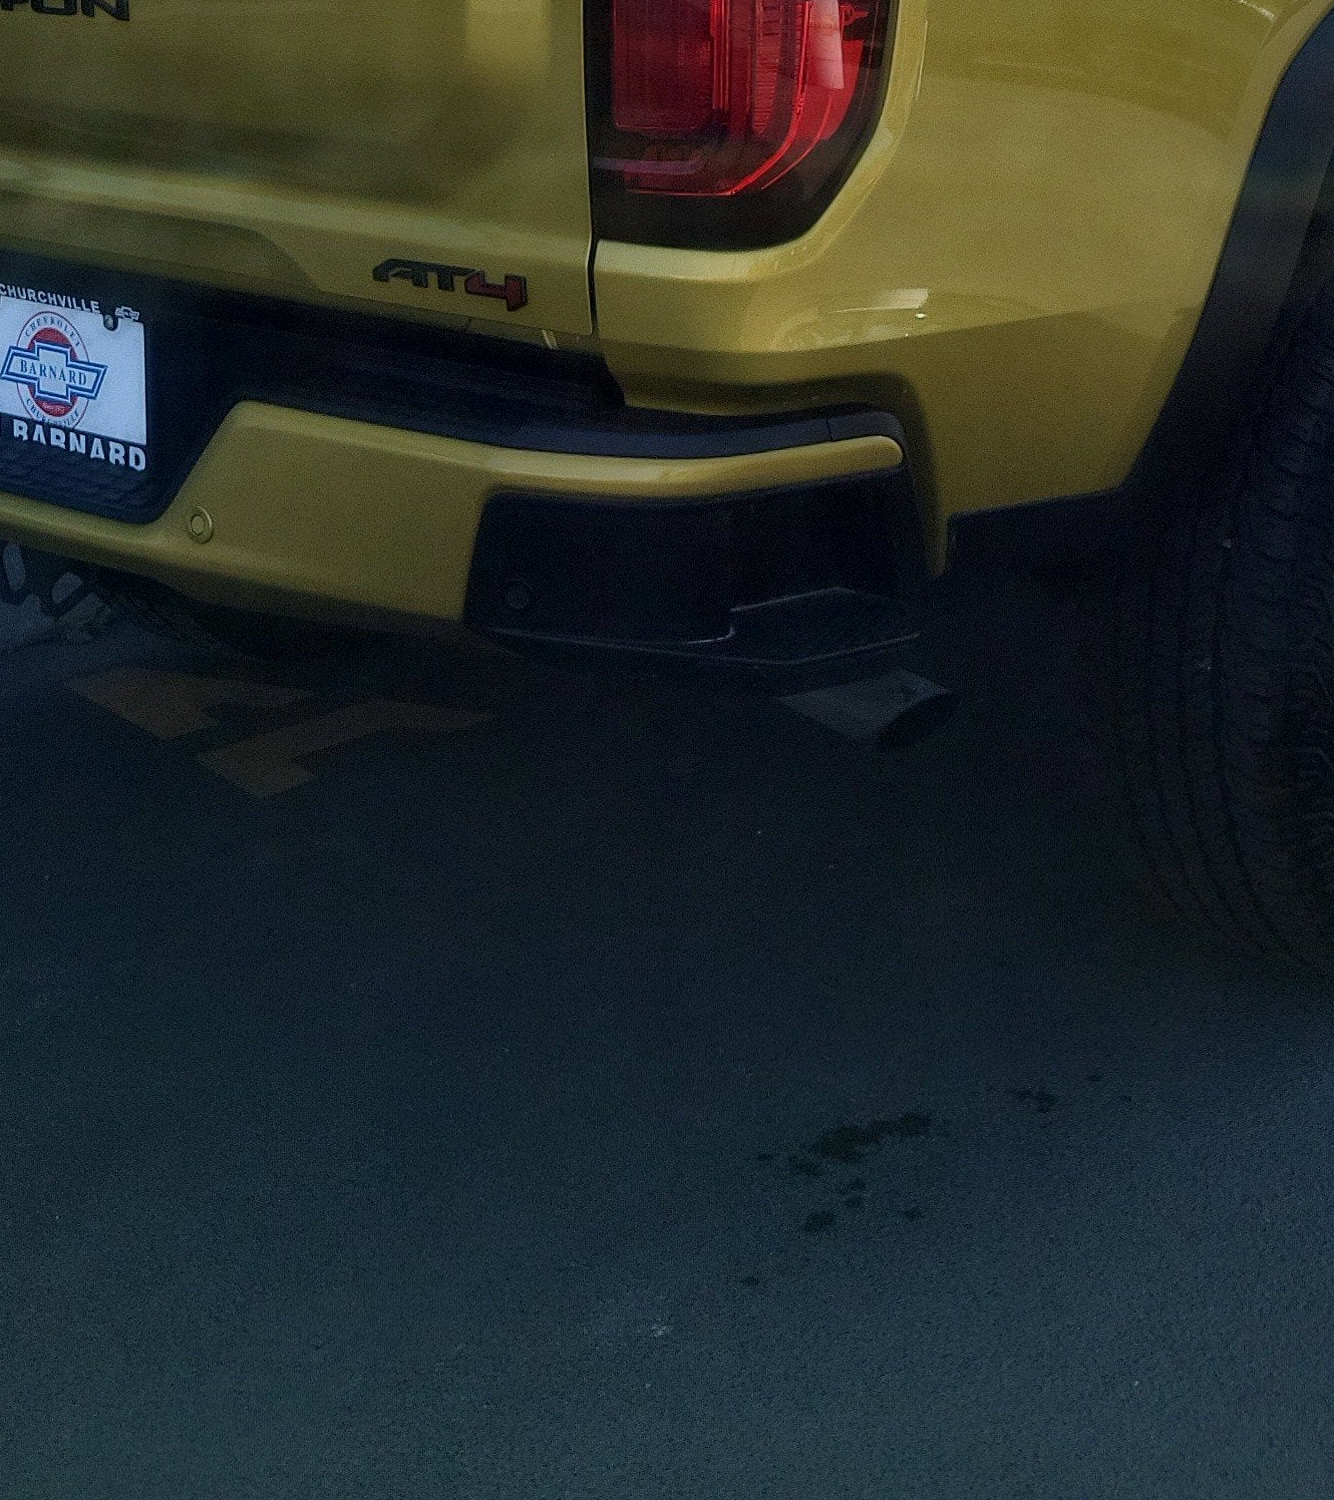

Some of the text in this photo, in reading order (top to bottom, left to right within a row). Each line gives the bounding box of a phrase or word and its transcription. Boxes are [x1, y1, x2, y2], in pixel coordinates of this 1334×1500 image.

[372, 258, 529, 312] AT4
[20, 360, 87, 386] BARNARD
[13, 418, 147, 472] BARNARD
